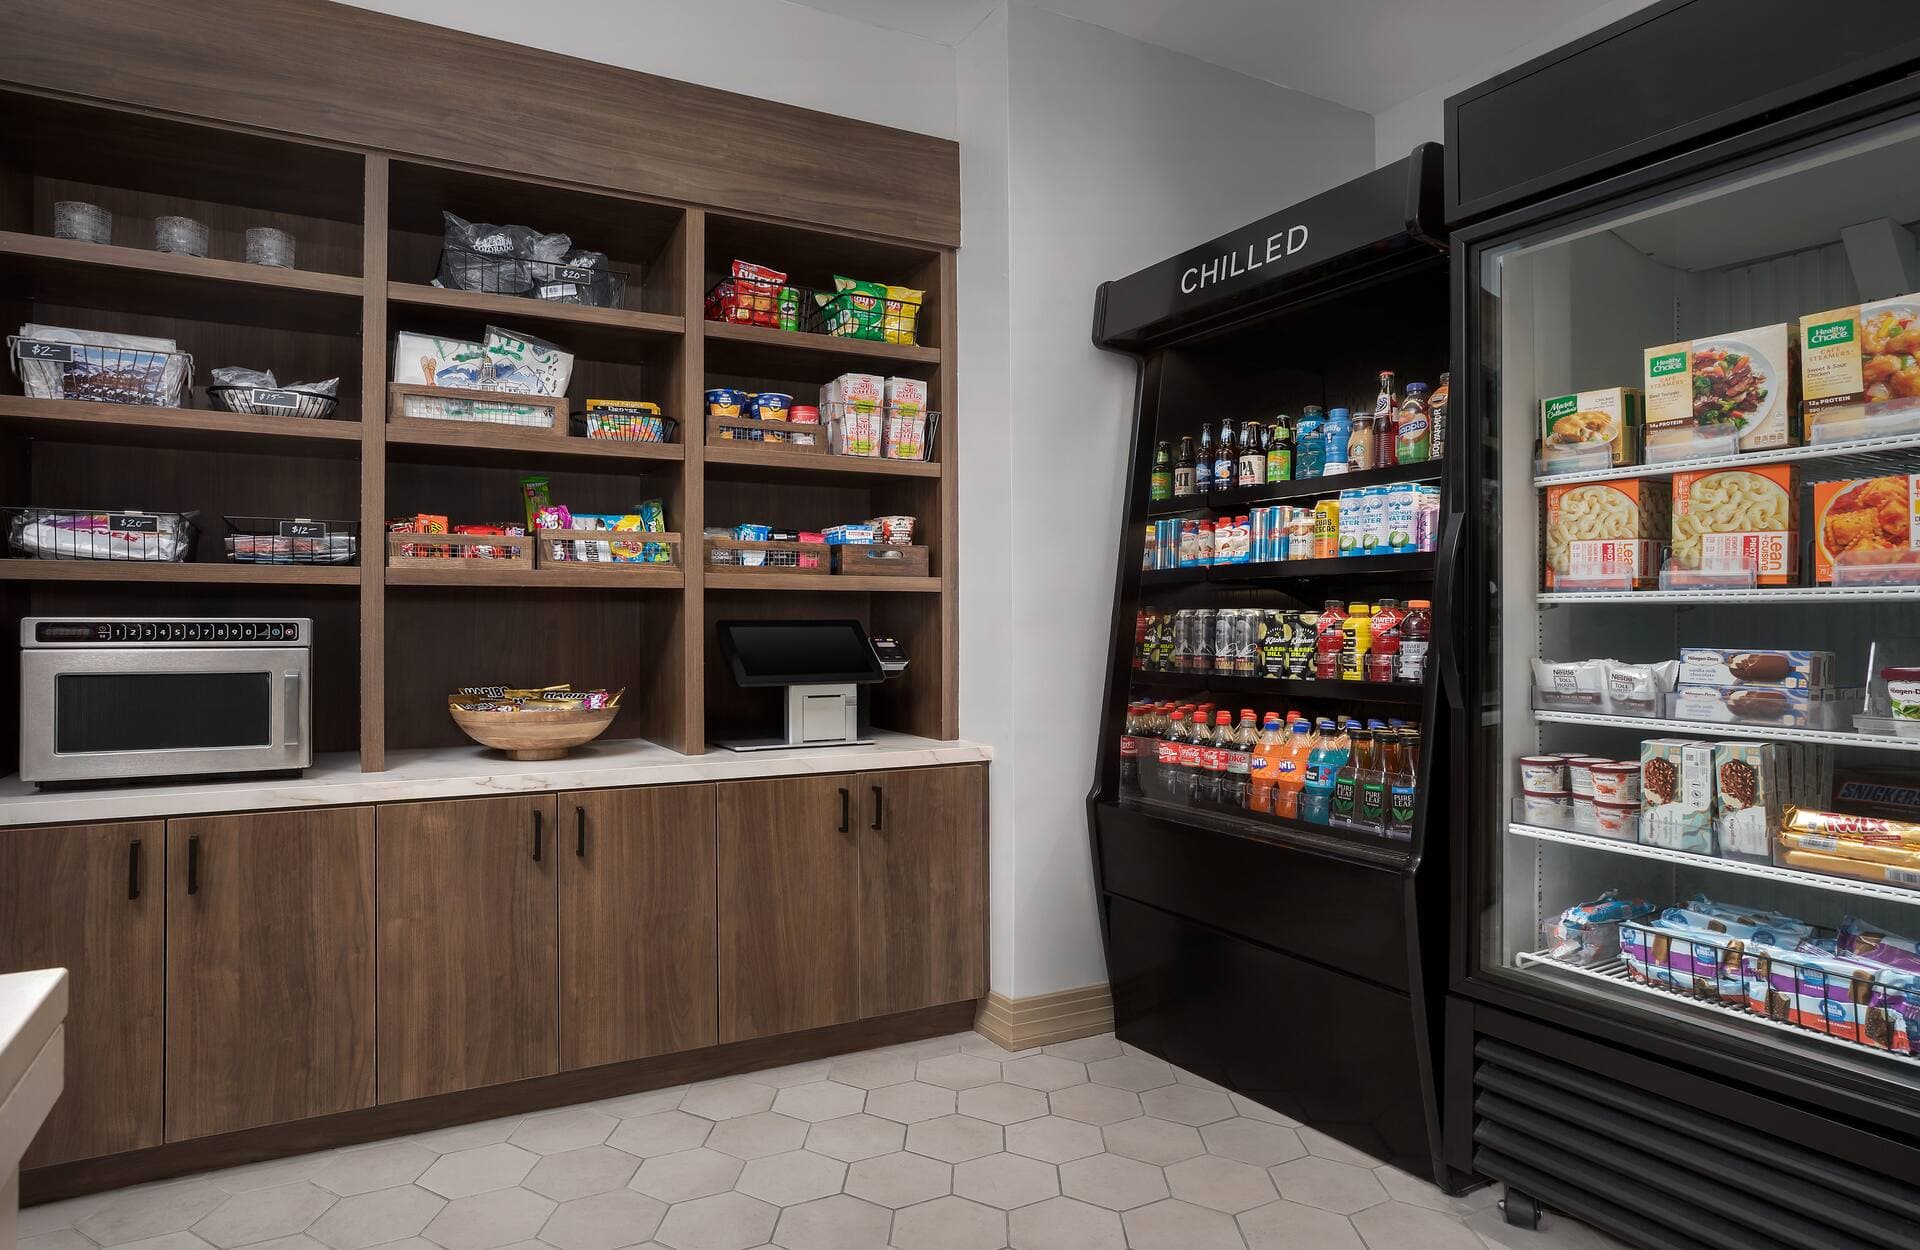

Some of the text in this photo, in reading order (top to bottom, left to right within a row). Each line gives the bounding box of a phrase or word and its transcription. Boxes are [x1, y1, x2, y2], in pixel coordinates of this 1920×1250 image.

[1181, 224, 1309, 294] CHILLED
[1816, 325, 1846, 336] Healthy
[1811, 331, 1848, 344] Choice
[1653, 361, 1682, 373] Choice
[1656, 357, 1681, 366] Healthy
[1820, 395, 1851, 405] PROTEIN
[1400, 420, 1427, 437] apple
[1659, 420, 1683, 428] PROTEIN
[1432, 408, 1442, 458] BODYARMOR
[1761, 540, 1769, 572] cuisine
[1769, 535, 1783, 571] Lean
[1342, 628, 1358, 673] PRIME
[1337, 783, 1353, 791] PURE
[1337, 790, 1353, 798] LEAF
